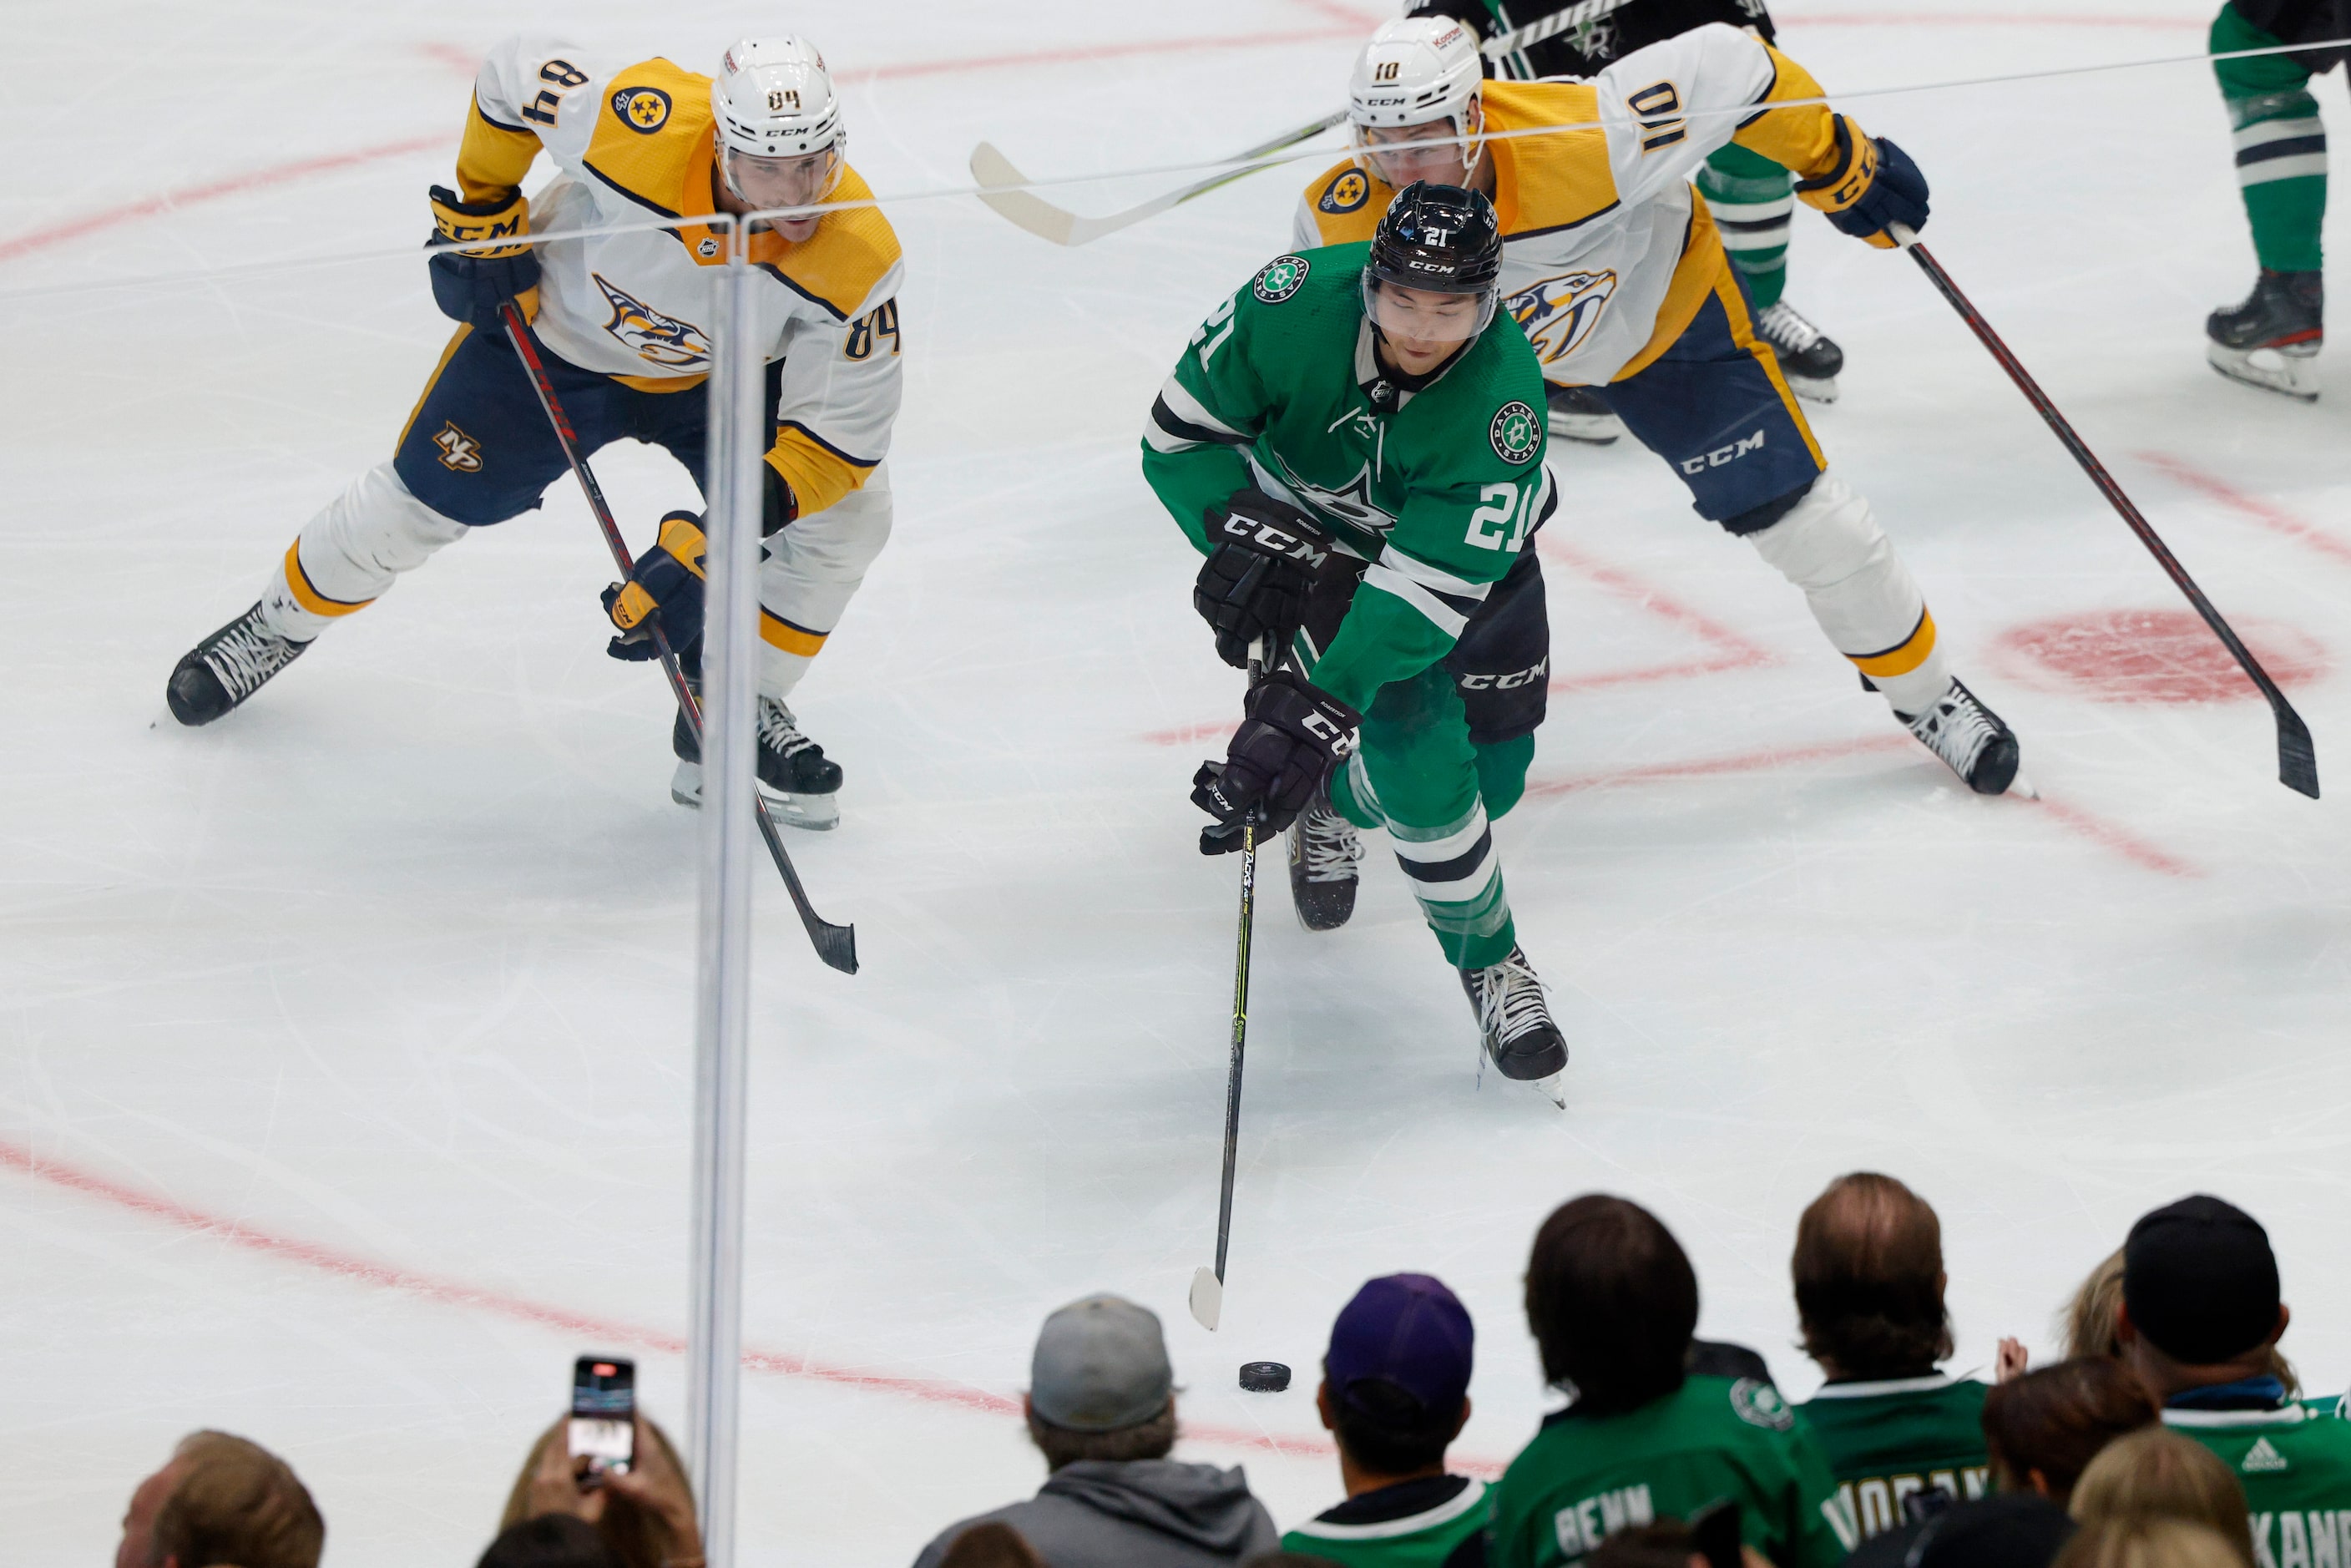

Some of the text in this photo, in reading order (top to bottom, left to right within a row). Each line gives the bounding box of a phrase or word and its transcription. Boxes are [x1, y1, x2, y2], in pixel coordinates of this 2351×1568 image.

[1375, 62, 1399, 81] 10
[519, 58, 589, 129] 84
[767, 89, 801, 111] 84
[1367, 98, 1406, 107] CCM
[766, 127, 809, 138] CCM
[1624, 79, 1688, 159] 10
[1423, 226, 1448, 248] 21
[1408, 260, 1455, 274] CCM
[842, 297, 901, 362] 84
[1494, 405, 1539, 460] DALLAS STARS
[1680, 428, 1765, 475] CCM
[1295, 518, 1322, 536] ROBERTSON
[1464, 482, 1533, 553] 21
[1223, 512, 1328, 569] CCM
[1460, 655, 1548, 690] CCM
[1319, 700, 1347, 719] ROBERTSON
[1211, 783, 1234, 812] CCM
[1243, 849, 1255, 888] TACKS
[1555, 1482, 1655, 1556] BENN
